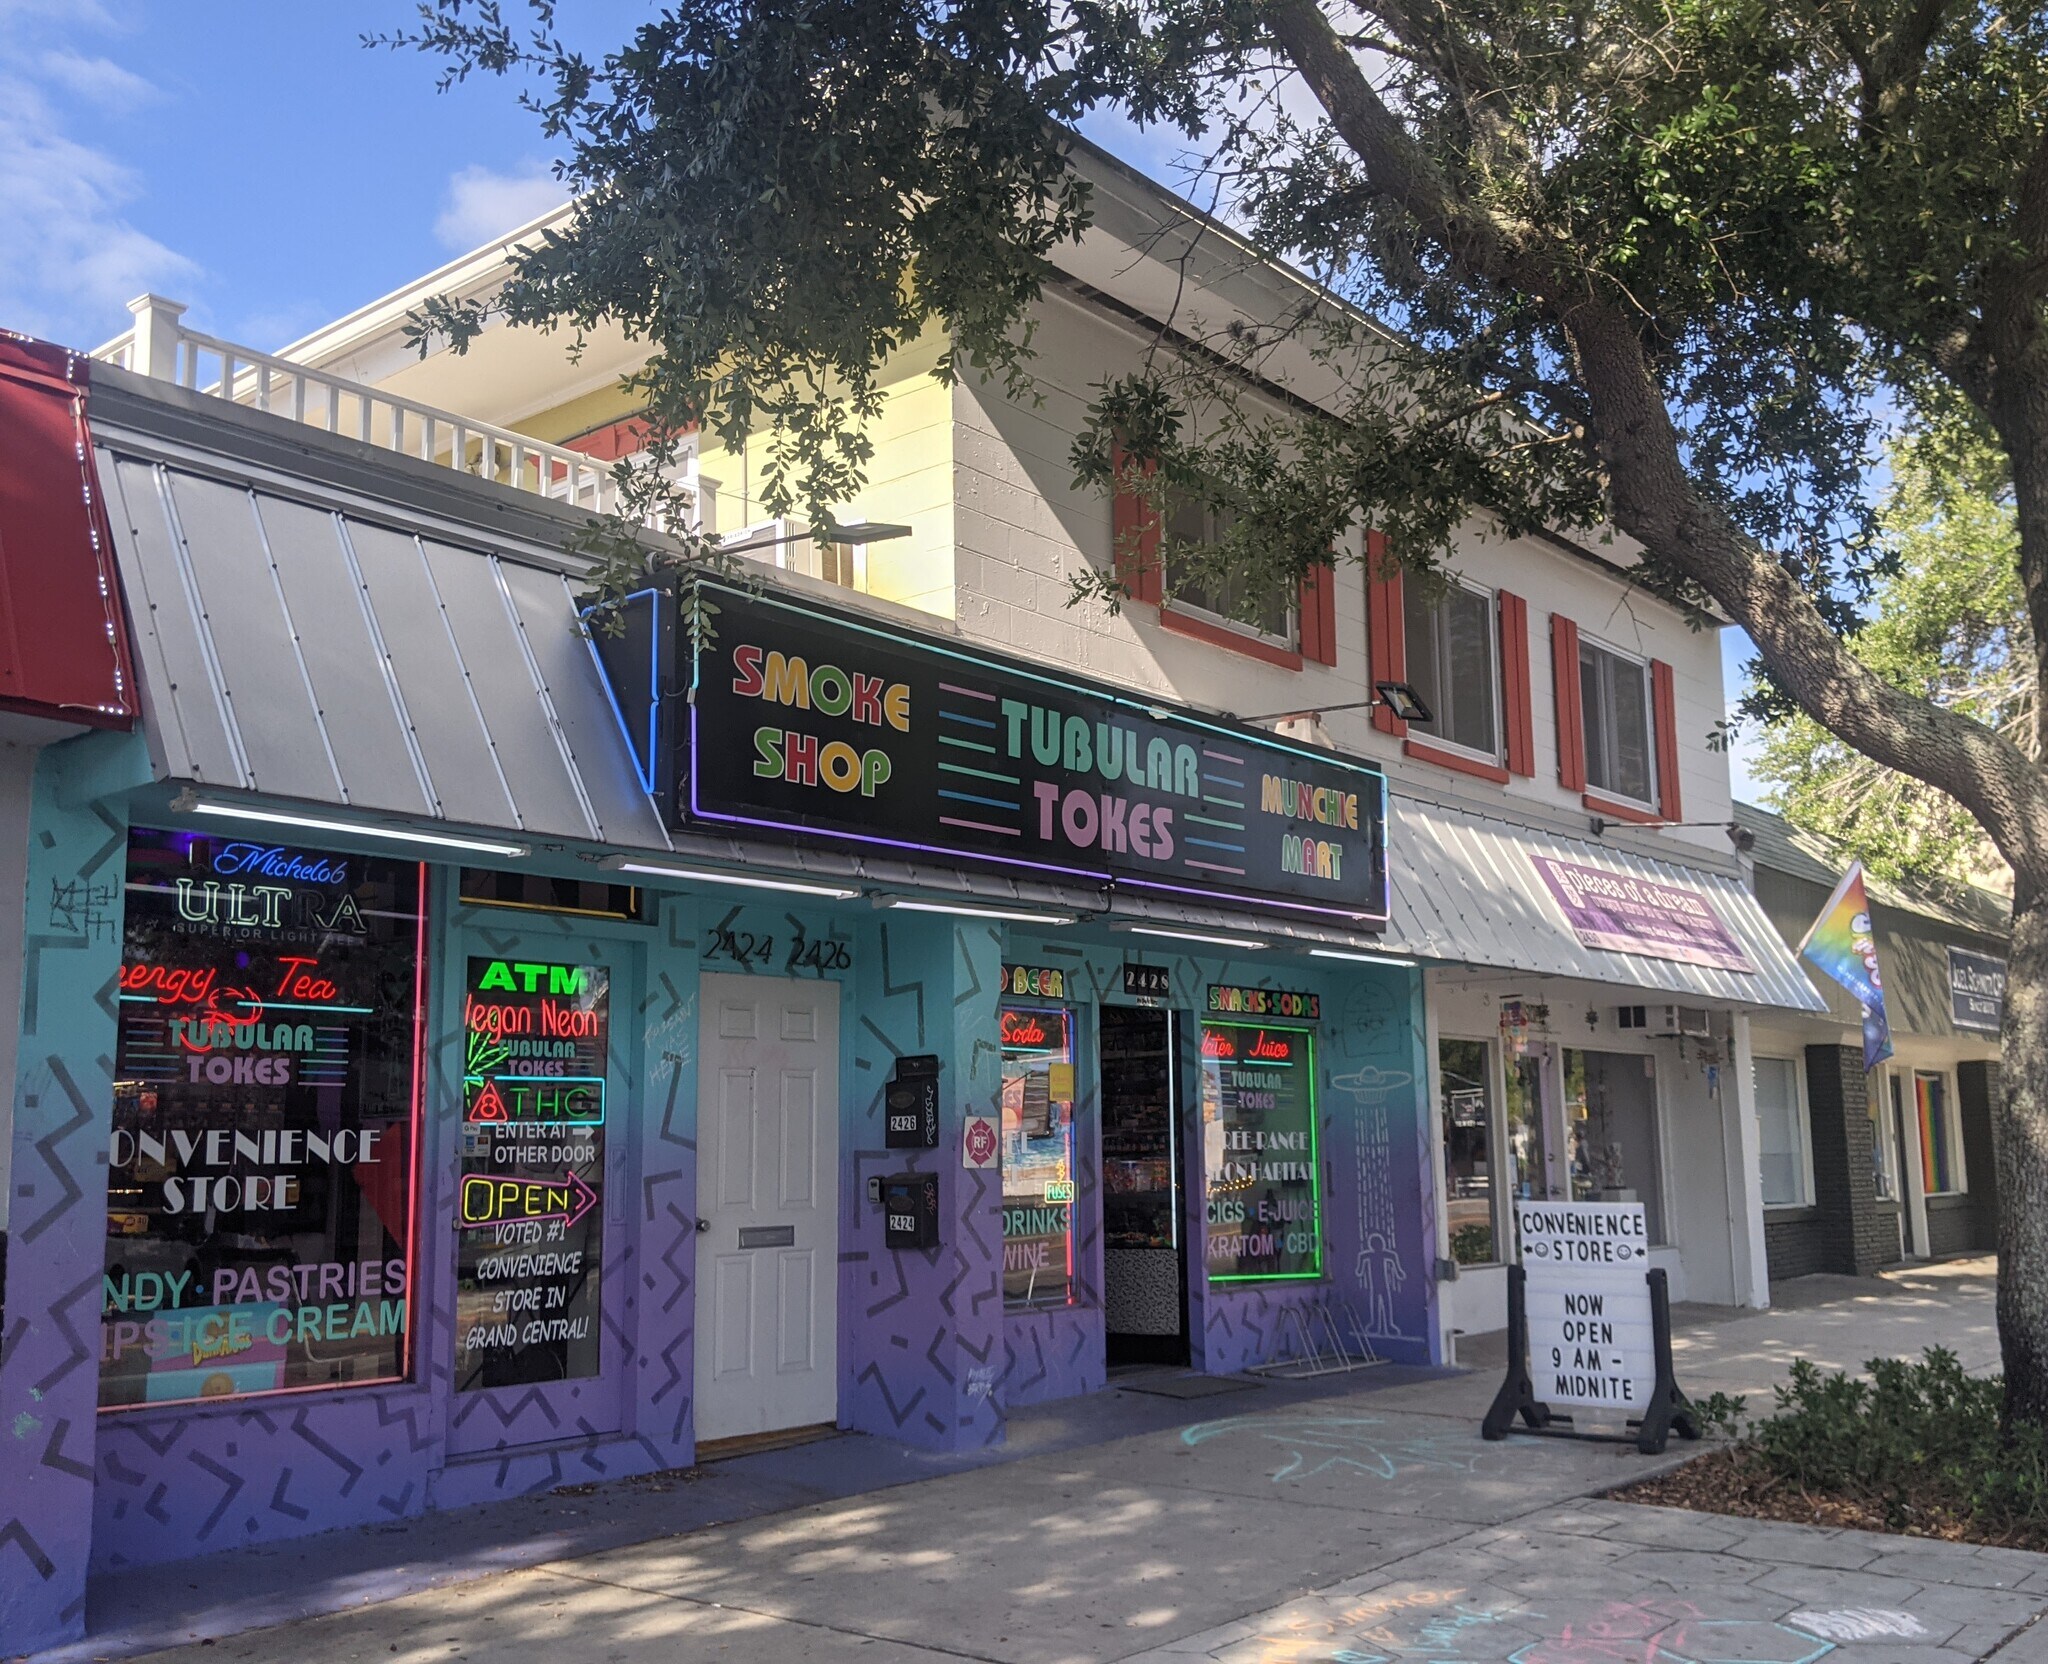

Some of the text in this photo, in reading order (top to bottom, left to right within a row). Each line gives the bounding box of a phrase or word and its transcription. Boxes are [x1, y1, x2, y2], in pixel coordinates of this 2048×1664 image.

[733, 644, 910, 732] SMOKE
[753, 726, 891, 797] SHOP
[1001, 698, 1199, 798] TUBULAR
[1260, 773, 1359, 830] MUNCHIE
[1033, 780, 1175, 861] TOKES
[213, 842, 346, 885] Michelob
[1281, 833, 1343, 881] MART
[176, 878, 367, 934] ULTRA
[1566, 868, 1625, 899] pieces
[1624, 879, 1644, 903] of
[1643, 887, 1658, 907] a
[1656, 884, 1709, 917] dream
[177, 922, 262, 939] SUPERIOR
[271, 930, 317, 943] LIGHT
[702, 929, 851, 970] 2424 2426
[119, 957, 336, 1003] ergy Tea
[478, 961, 588, 995] ATM
[1013, 966, 1063, 998] BEER
[1126, 971, 1169, 990] 2428
[1209, 986, 1319, 1017] SNACKS SODAS
[541, 998, 598, 1037] Neon
[1001, 1012, 1044, 1044] Soda
[168, 1019, 314, 1051] TUBULAR
[499, 1039, 576, 1059] TUBULAR
[1249, 1030, 1289, 1058] Juice
[187, 1055, 290, 1085] TOKES
[507, 1060, 565, 1077] TOKES
[1231, 1071, 1282, 1090] TUBULAR
[509, 1087, 590, 1118] THC
[1238, 1091, 1275, 1109] TOKES
[495, 1121, 567, 1139] ENTER AT
[892, 1117, 915, 1130] 2426
[109, 1129, 381, 1168] ONVENIENCE
[495, 1145, 595, 1163] OTHER DOOR
[973, 1135, 987, 1148] RF
[1220, 1131, 1309, 1150] REE-RANGE
[1210, 1161, 1248, 1182] EON
[163, 1175, 297, 1215] STORE
[464, 1179, 568, 1221] OPEN
[1047, 1184, 1071, 1199] FUSES
[891, 1216, 914, 1230] 2424
[1003, 1208, 1071, 1236] DRINKS
[1206, 1200, 1245, 1224] CIGS
[1522, 1212, 1643, 1236] CONVENIENCE
[495, 1220, 565, 1245] VOTED #1
[1207, 1232, 1318, 1258] KRATOM CBD
[477, 1251, 582, 1280] CONVENIENCE
[1003, 1242, 1050, 1271] WINE
[1554, 1241, 1614, 1262] STORE
[102, 1259, 406, 1312] NDY PASTRIES
[493, 1285, 566, 1314] STORE IN
[1565, 1294, 1603, 1316] NOW
[100, 1318, 168, 1362] IPS
[183, 1311, 253, 1352] ICE
[265, 1299, 406, 1344] CREAM
[466, 1315, 589, 1350] GRAND CENTRAL!
[1563, 1321, 1613, 1344] OPEN
[1552, 1348, 1561, 1368] 9
[1574, 1348, 1601, 1371] AM
[1556, 1375, 1633, 1401] MIDNITE
